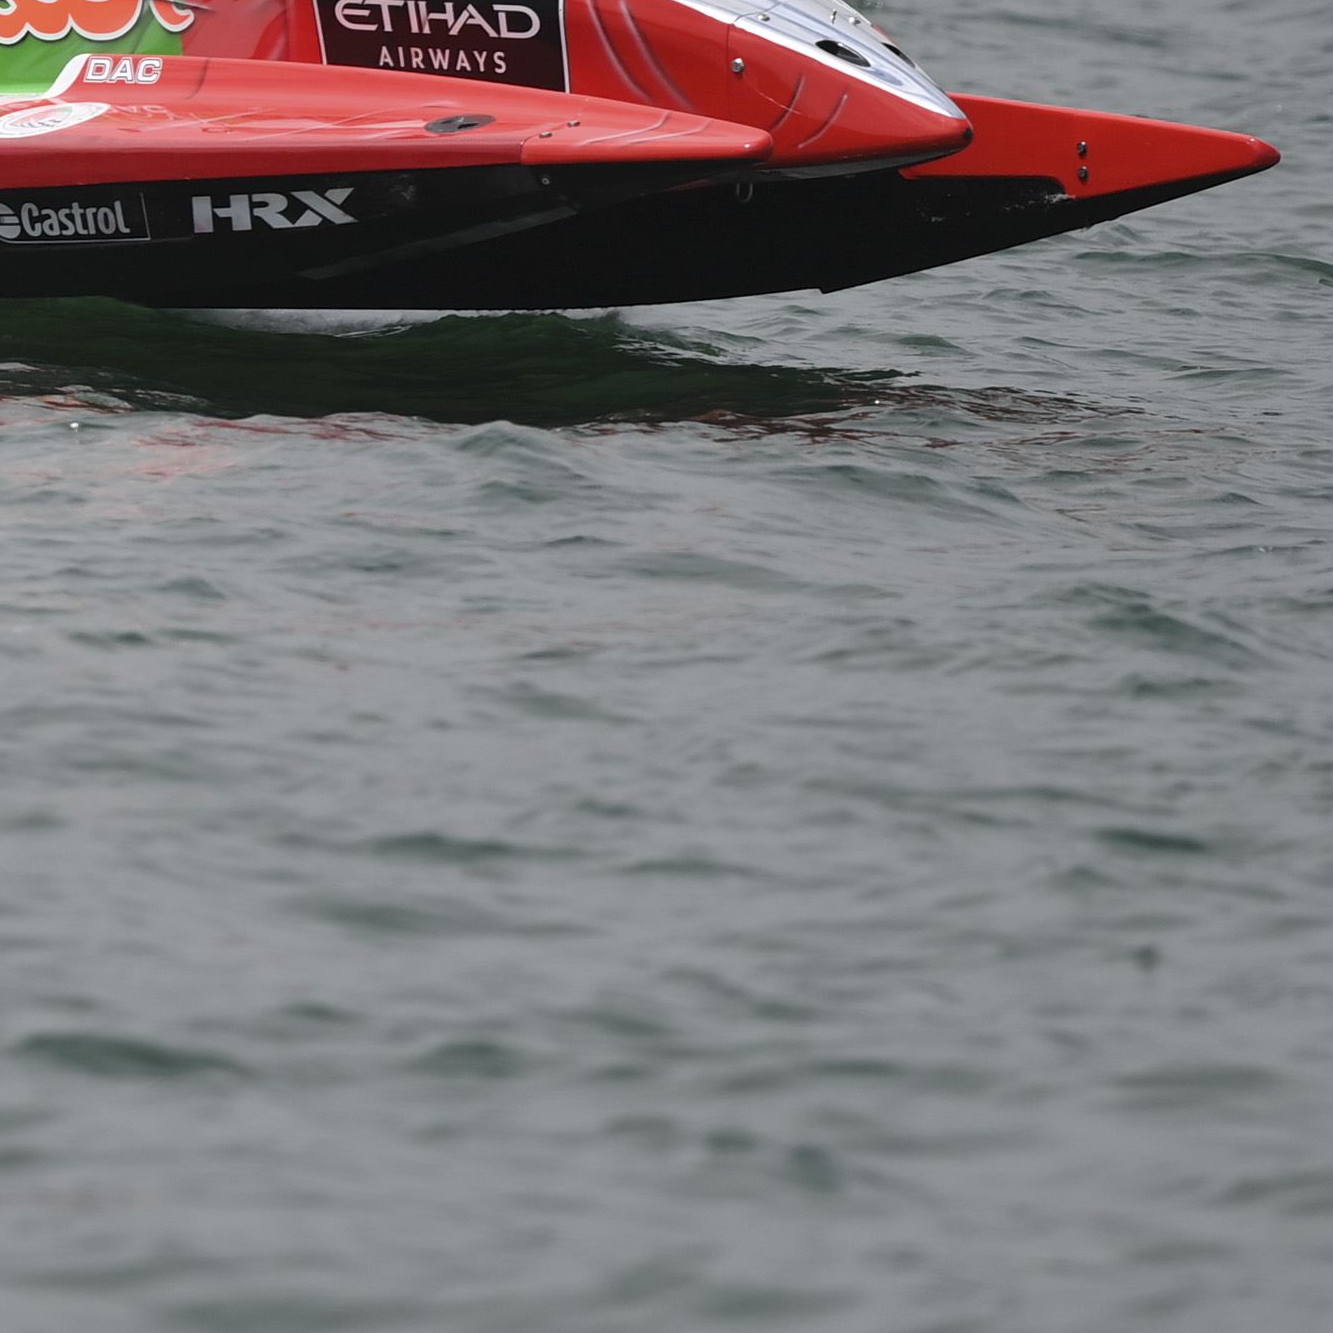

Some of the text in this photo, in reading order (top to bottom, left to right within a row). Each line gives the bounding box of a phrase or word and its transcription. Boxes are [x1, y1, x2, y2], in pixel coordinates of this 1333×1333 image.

[83, 56, 164, 85] DAC
[378, 45, 508, 74] AIRWAYS
[20, 200, 132, 237] Castrol
[191, 187, 360, 234] HRX
